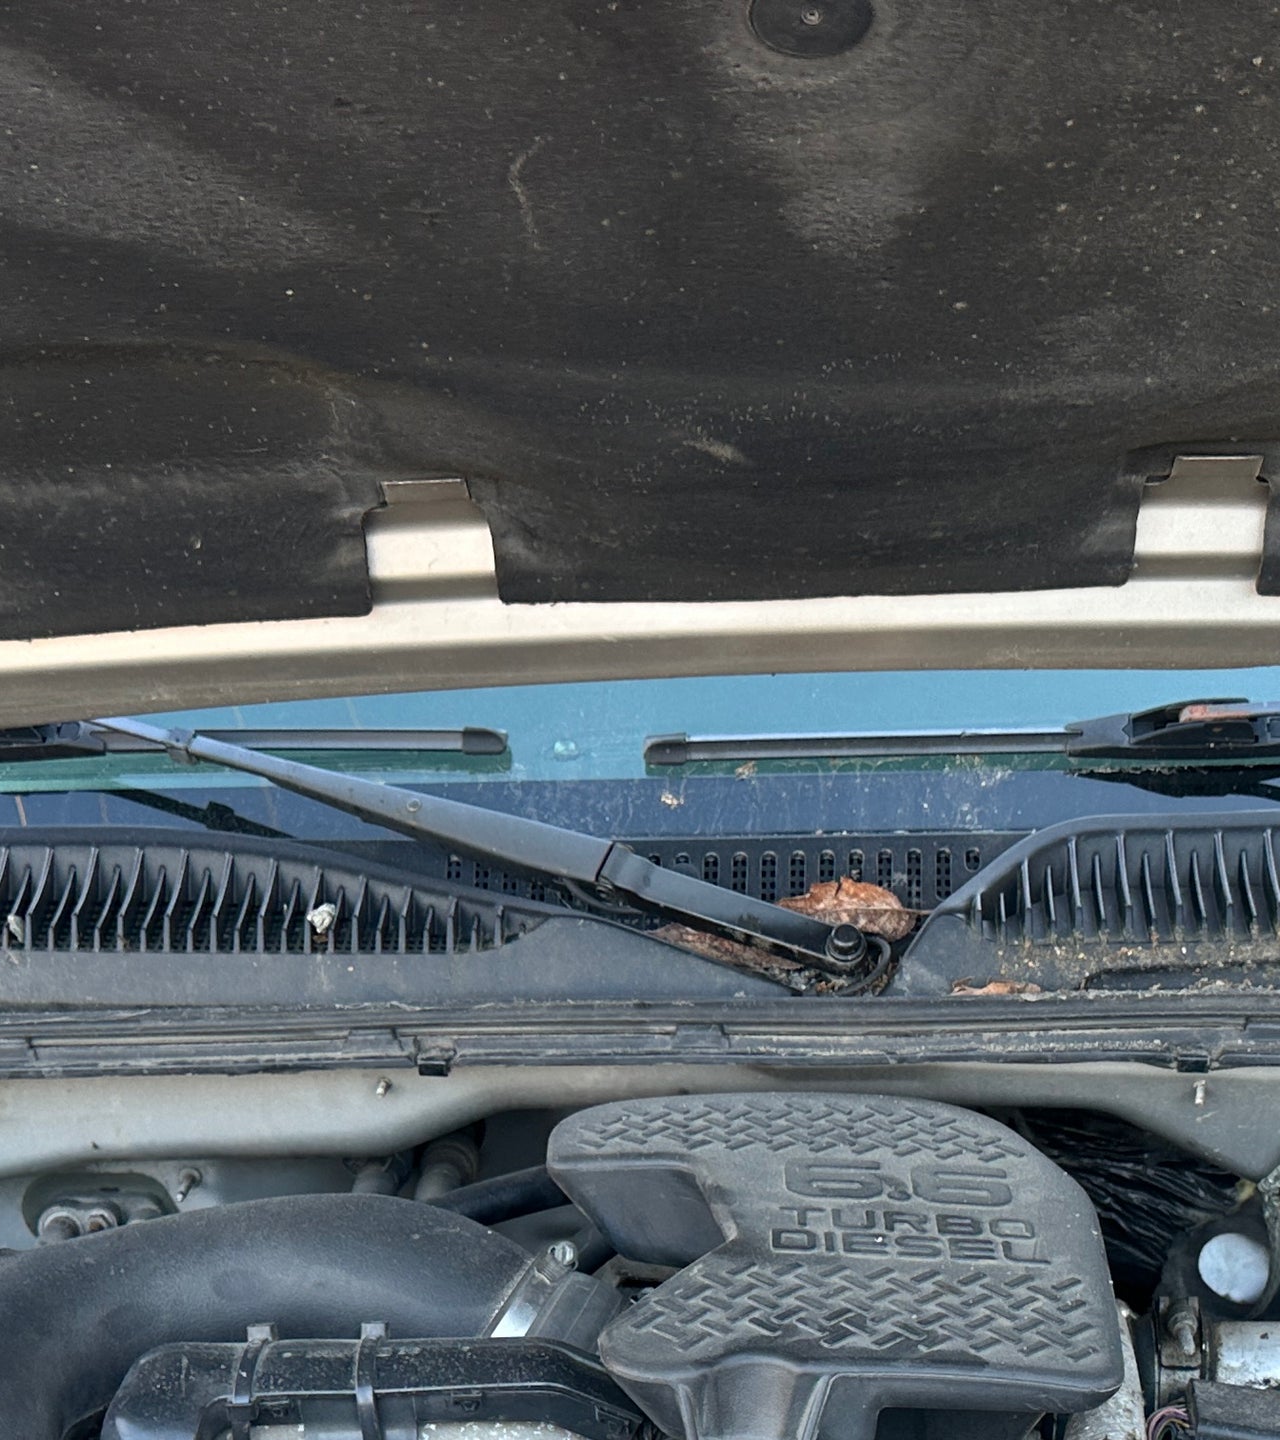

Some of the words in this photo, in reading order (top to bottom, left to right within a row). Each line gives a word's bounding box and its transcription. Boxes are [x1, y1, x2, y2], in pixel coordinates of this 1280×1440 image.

[784, 1159, 1013, 1206] 6.6
[779, 1206, 1035, 1239] TURBO
[771, 1227, 1051, 1265] DIESEL
